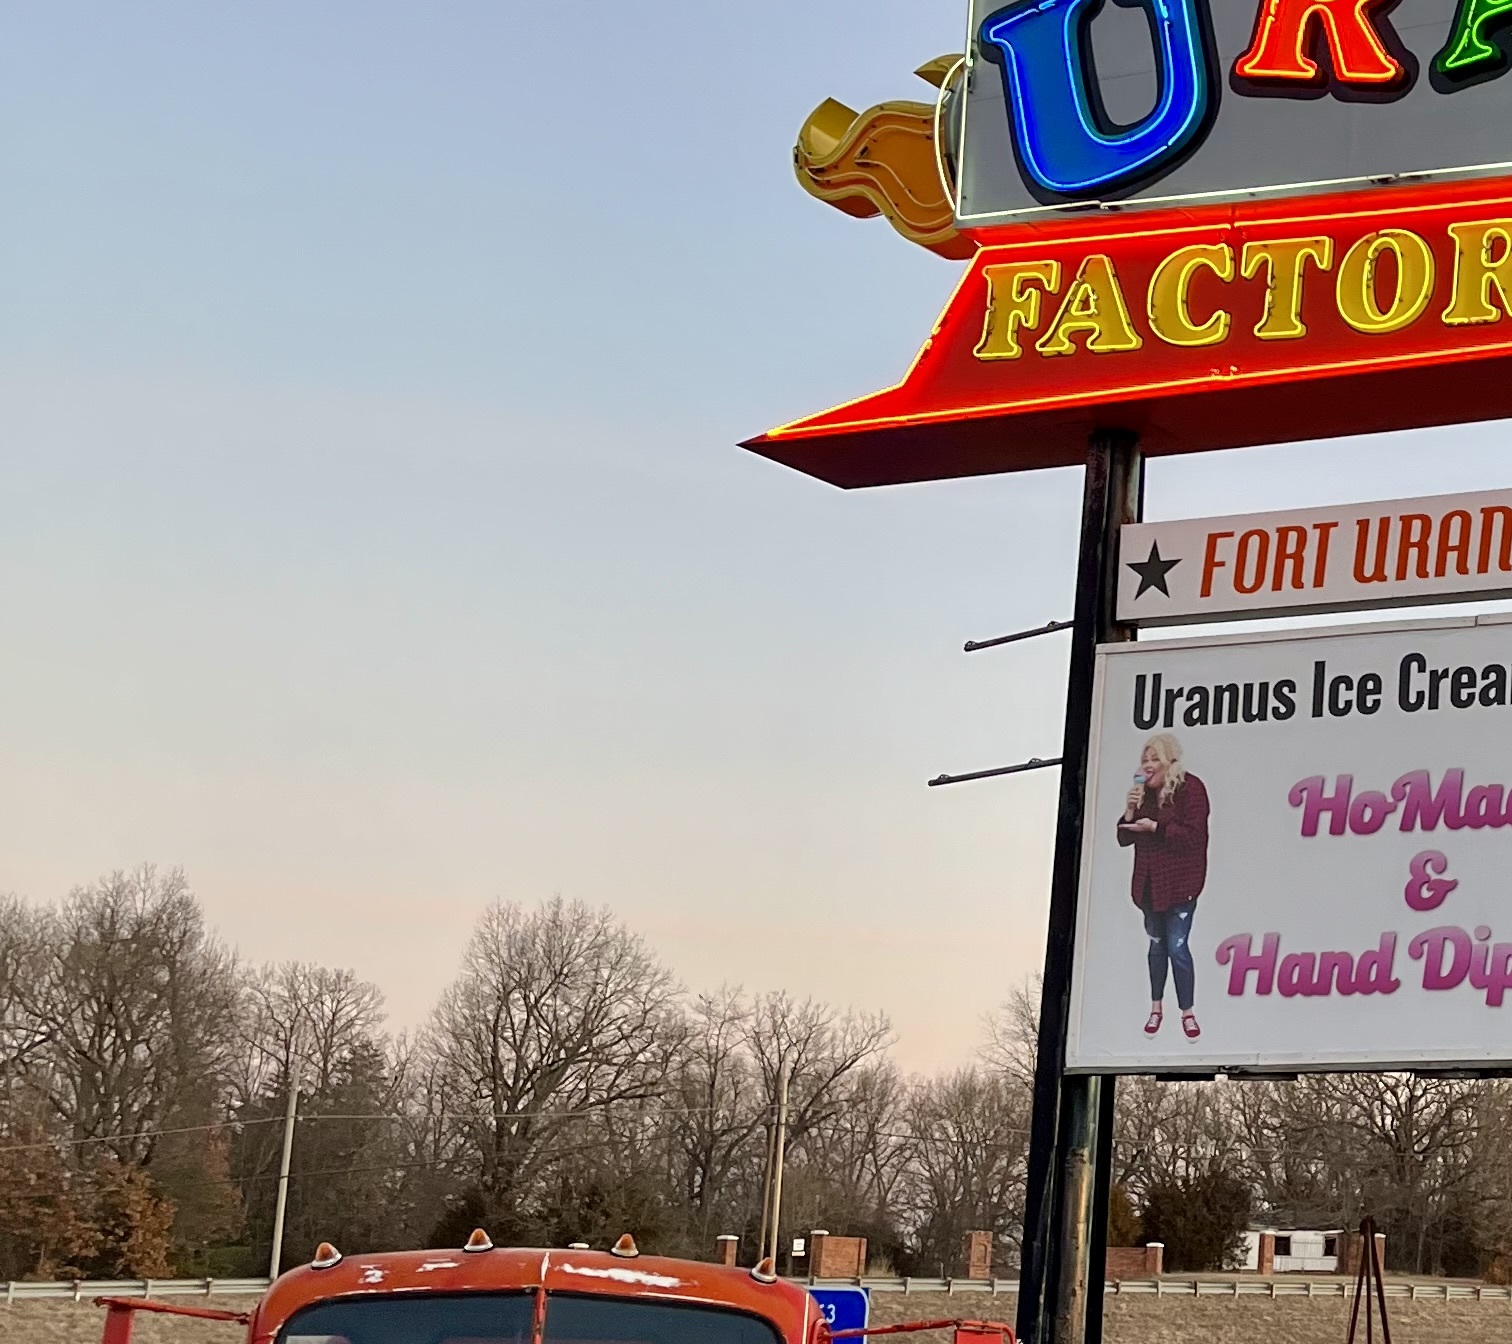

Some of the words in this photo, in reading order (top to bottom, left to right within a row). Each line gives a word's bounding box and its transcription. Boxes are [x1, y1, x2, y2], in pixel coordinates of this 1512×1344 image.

[1198, 520, 1339, 599] FORT
[1132, 670, 1297, 730] Uranus
[1311, 659, 1383, 719] Ice
[1404, 849, 1459, 912] &
[1215, 929, 1401, 999] Hand
